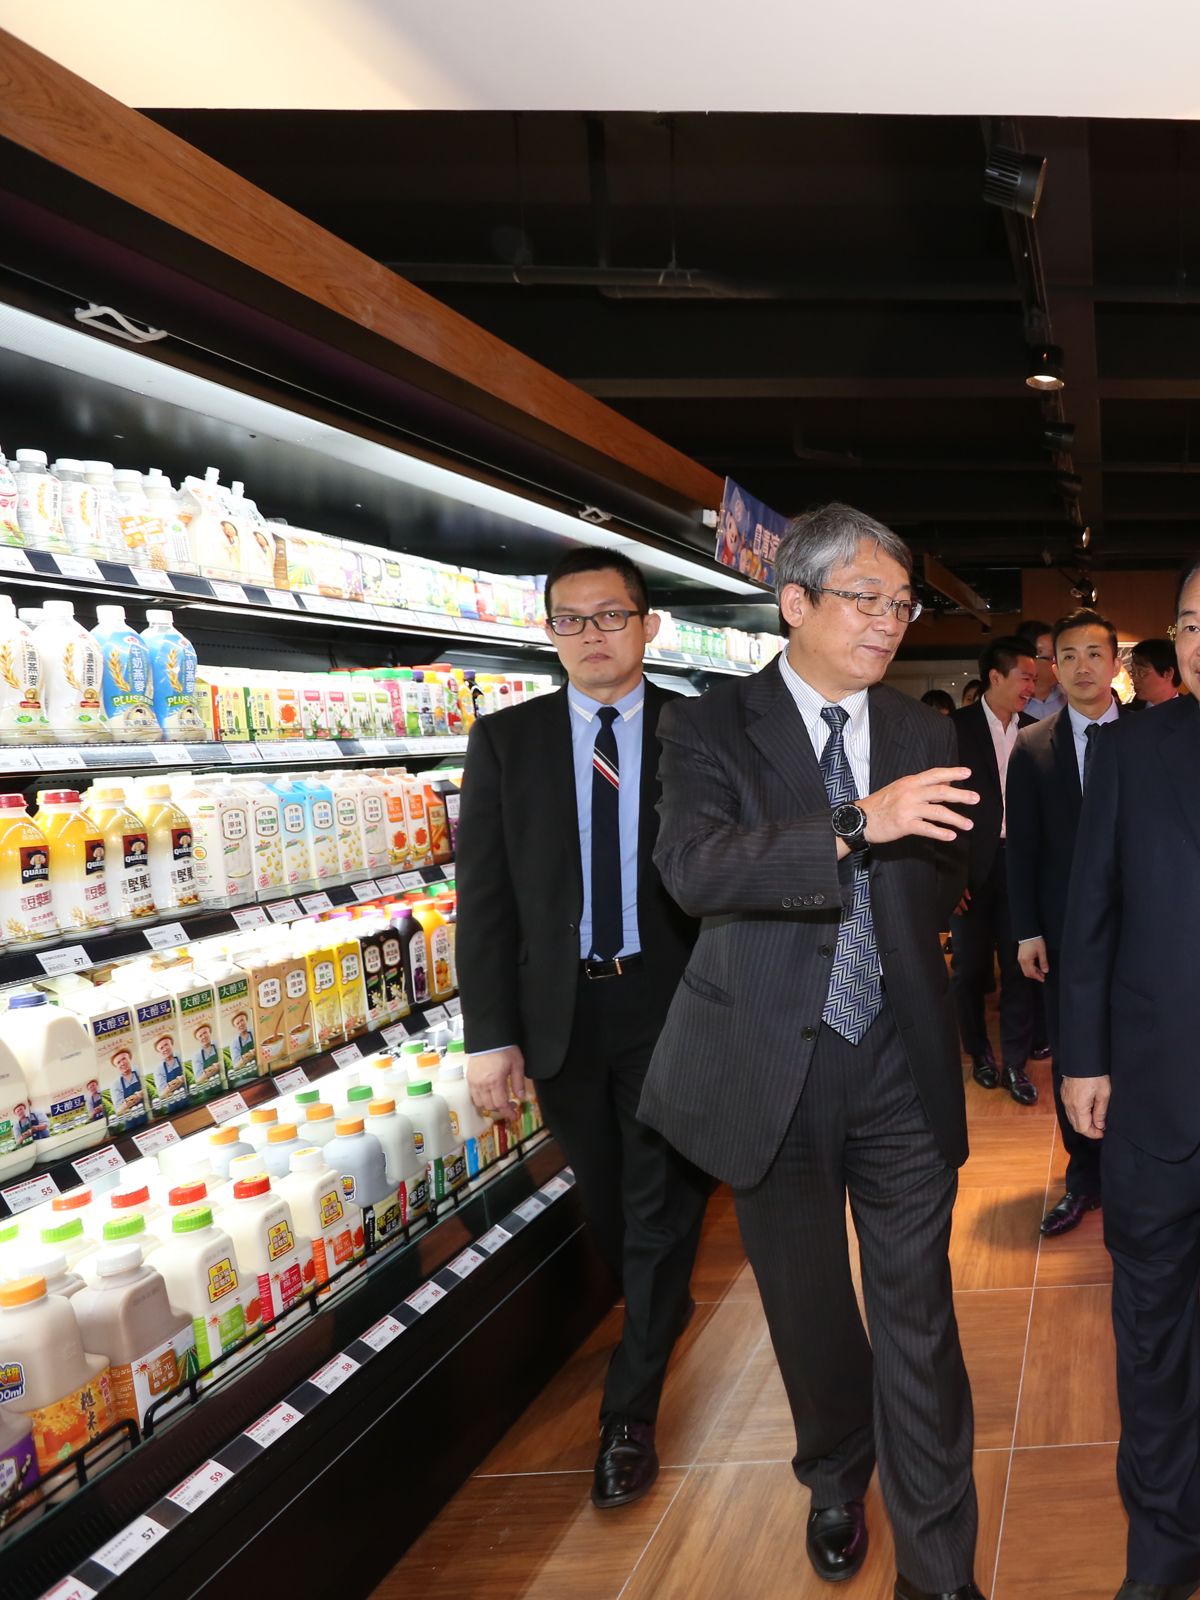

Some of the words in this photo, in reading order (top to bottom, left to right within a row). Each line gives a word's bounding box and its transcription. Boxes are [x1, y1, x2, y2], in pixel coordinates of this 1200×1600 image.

[113, 695, 139, 706] PLUS
[167, 695, 189, 706] PLUS
[174, 847, 192, 855] QUAK
[125, 854, 148, 863] QUAKE
[87, 860, 104, 869] QUAK
[23, 868, 48, 878] QUAKE
[174, 933, 183, 942] 57
[74, 957, 84, 966] 57
[184, 992, 211, 1007] 大醇豆
[140, 1001, 171, 1020] 大醇豆
[96, 1013, 130, 1034] 大醇豆
[53, 1098, 84, 1114] 大醇豆
[164, 1133, 175, 1142] 28
[108, 1157, 119, 1167] 55
[41, 1186, 53, 1196] 55
[341, 1363, 353, 1372] 58
[282, 1413, 294, 1423] 58
[209, 1471, 223, 1482] 59
[141, 1528, 155, 1541] 57
